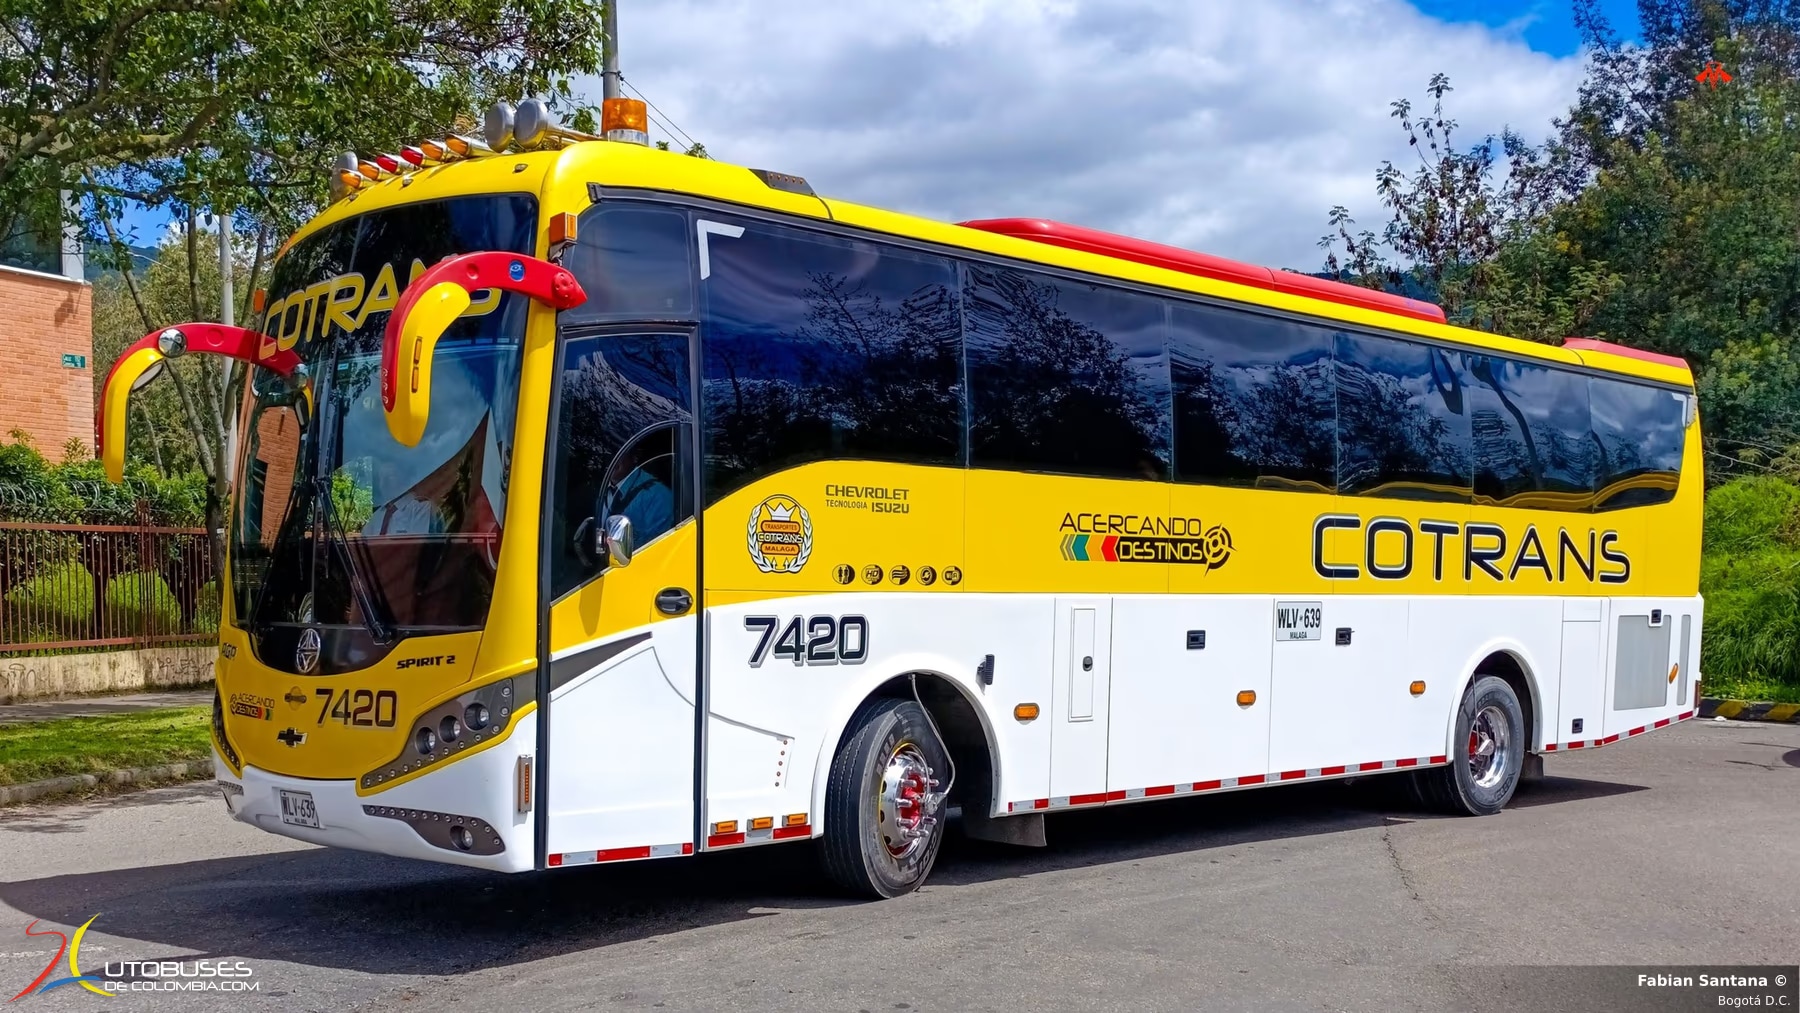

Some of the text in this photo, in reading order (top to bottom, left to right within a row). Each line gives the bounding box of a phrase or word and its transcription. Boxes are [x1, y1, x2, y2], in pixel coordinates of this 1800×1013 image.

[259, 258, 502, 360] COTRA
[826, 484, 909, 500] CHEVROLET
[826, 499, 909, 514] TECNOLOGIA ISUZU
[1059, 512, 1201, 536] ACERCANDO
[757, 532, 804, 543] COTRANS
[1120, 541, 1203, 560] DESTINOS
[1312, 513, 1631, 584] COTRANS
[744, 614, 869, 668] 7420
[396, 655, 456, 669] SPIRIT 2
[316, 688, 398, 730] 7420
